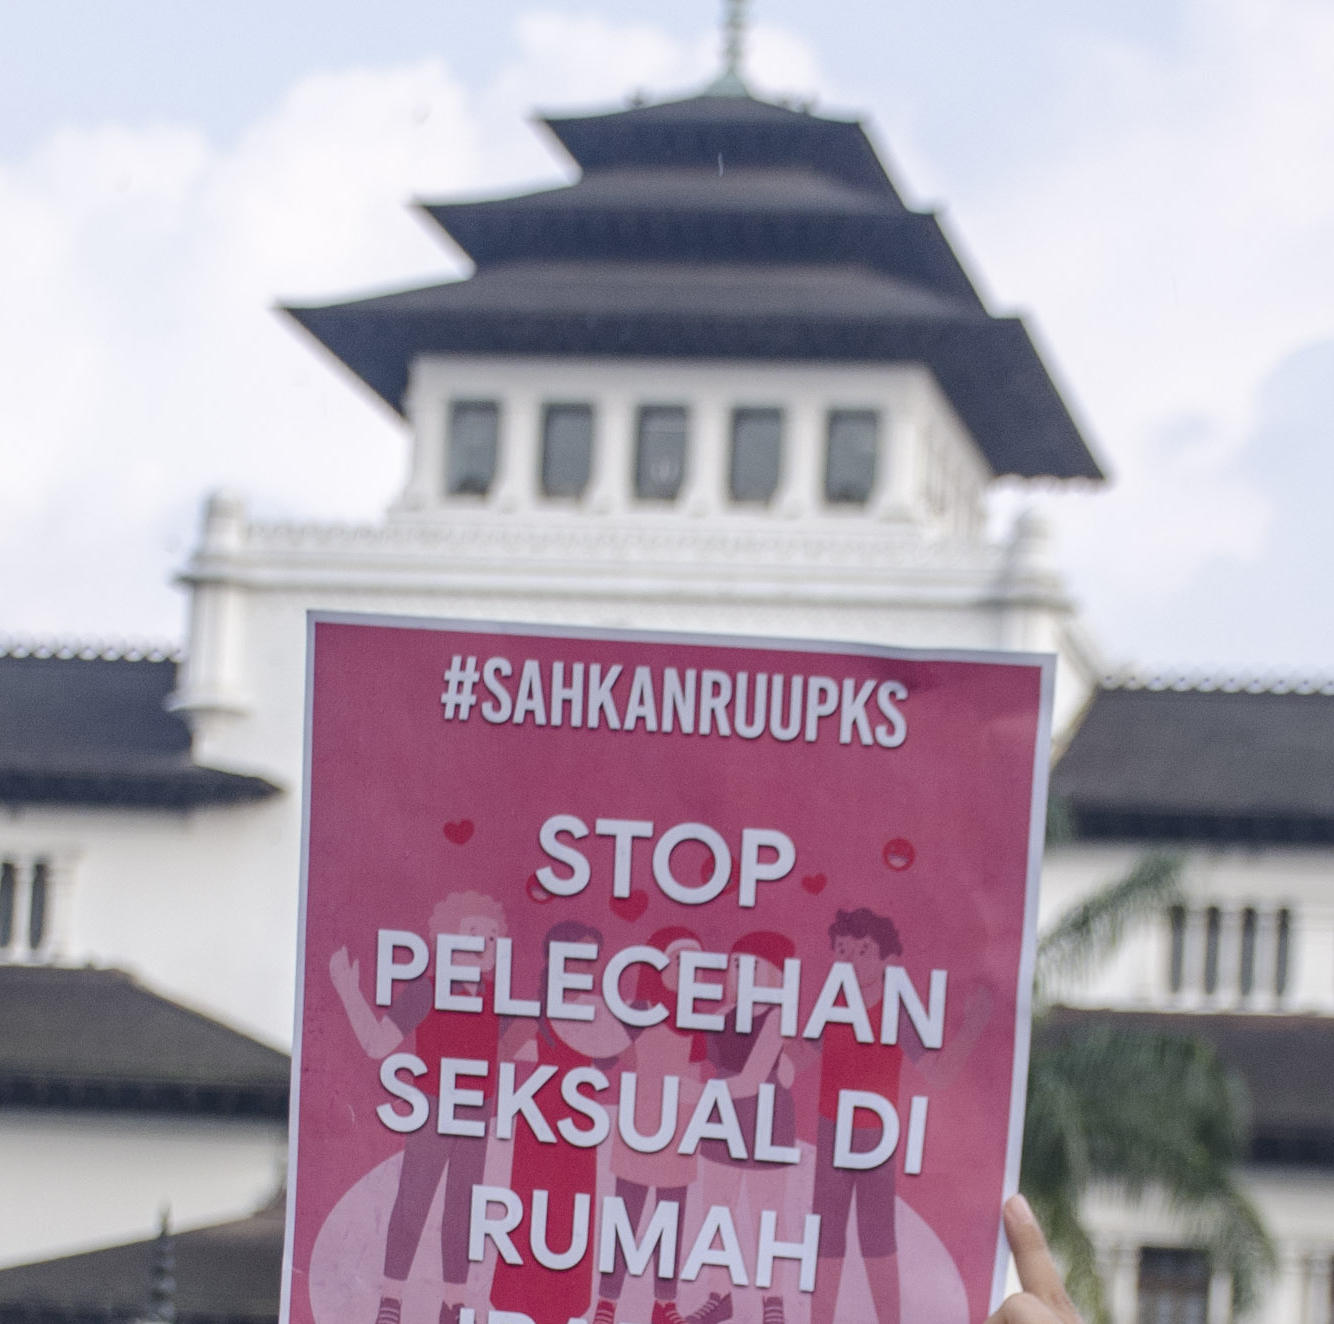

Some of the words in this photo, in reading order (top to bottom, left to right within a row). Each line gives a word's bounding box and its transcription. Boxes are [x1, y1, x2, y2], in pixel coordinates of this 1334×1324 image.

[441, 655, 908, 748] #SAHKANRUUPKS
[536, 814, 796, 907] STOP
[375, 929, 947, 1049] PELECEHAN
[376, 1053, 801, 1165] SEKSUAL
[834, 1090, 928, 1174] DI
[468, 1184, 821, 1292] RUMAH
